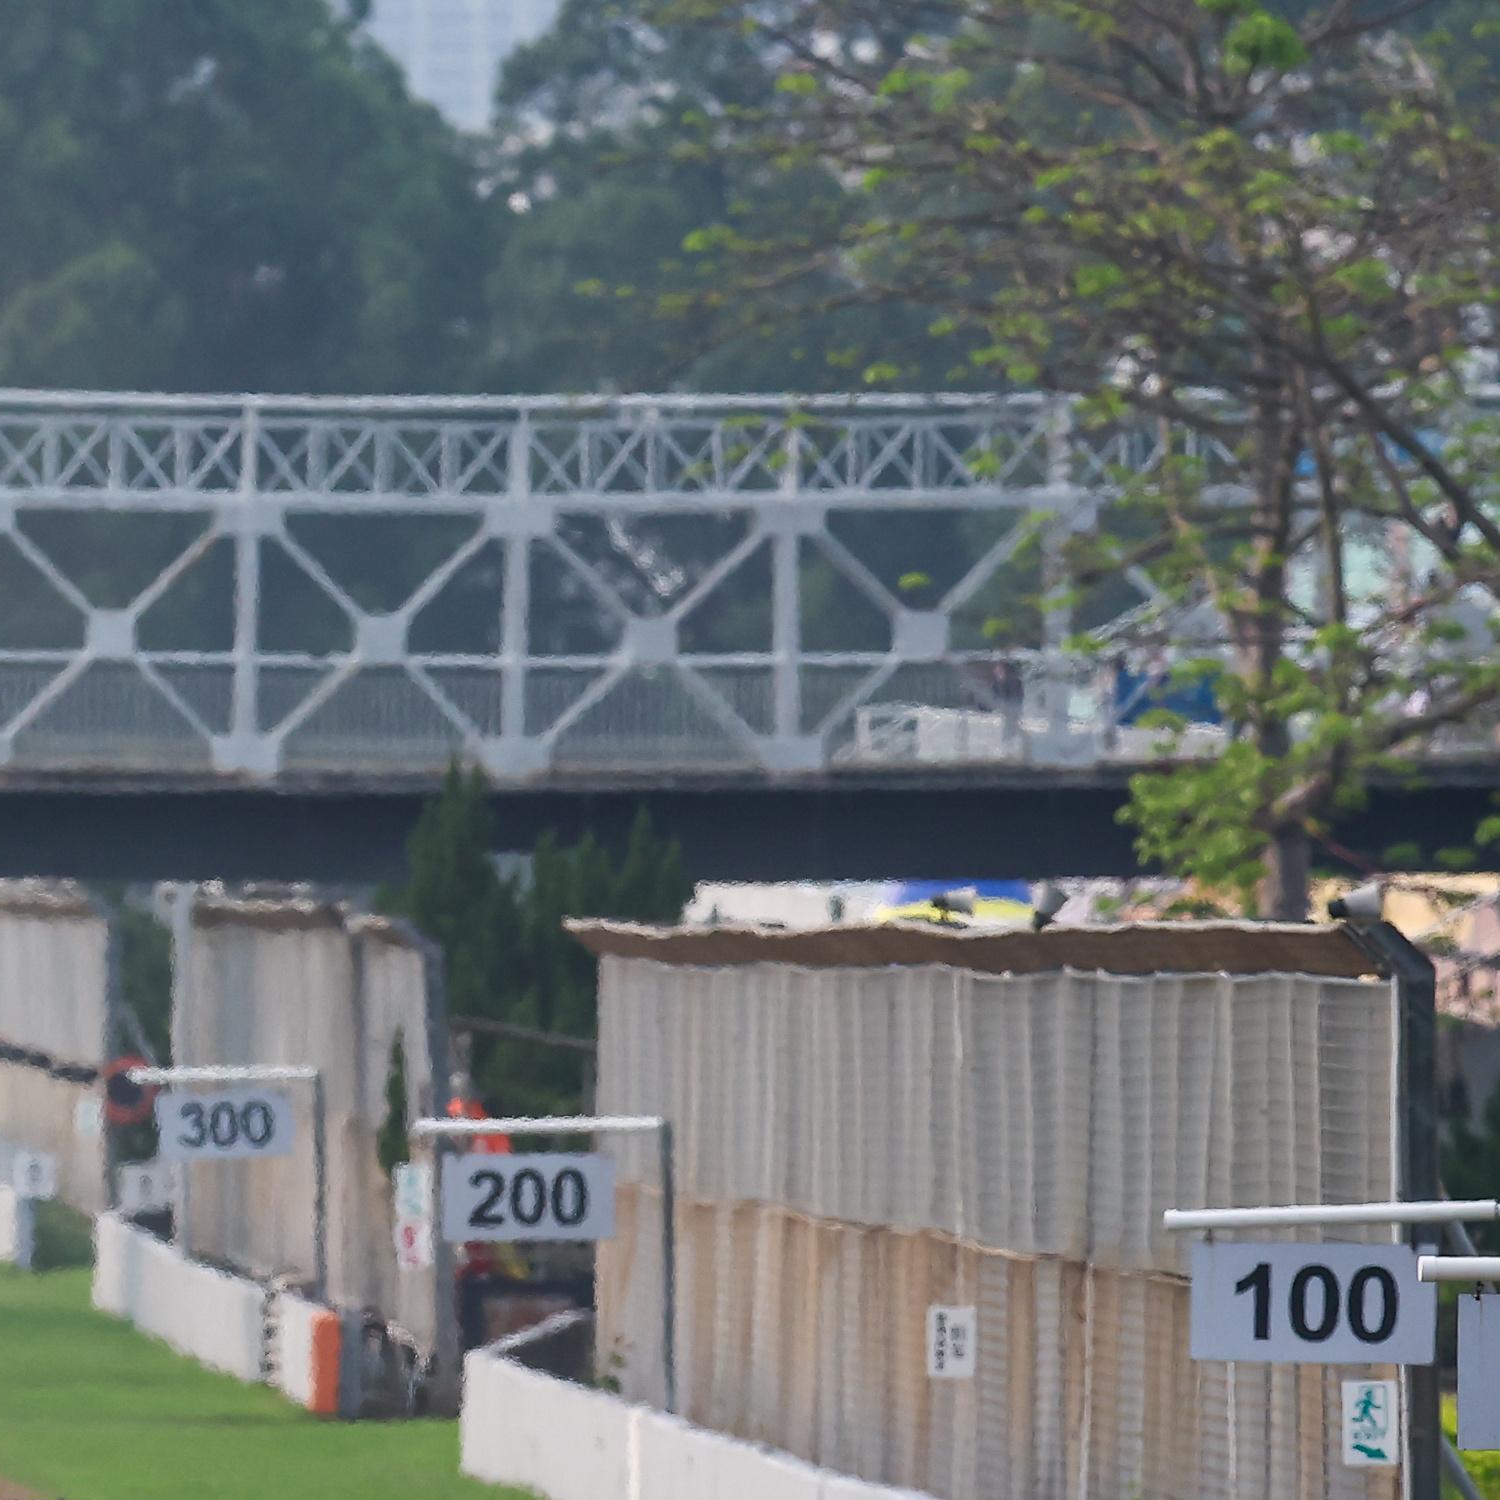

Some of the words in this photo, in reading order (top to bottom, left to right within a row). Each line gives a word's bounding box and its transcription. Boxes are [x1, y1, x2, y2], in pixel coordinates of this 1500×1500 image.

[177, 1100, 275, 1149] 300
[468, 1167, 588, 1227] 200
[1234, 1262, 1400, 1344] 100
